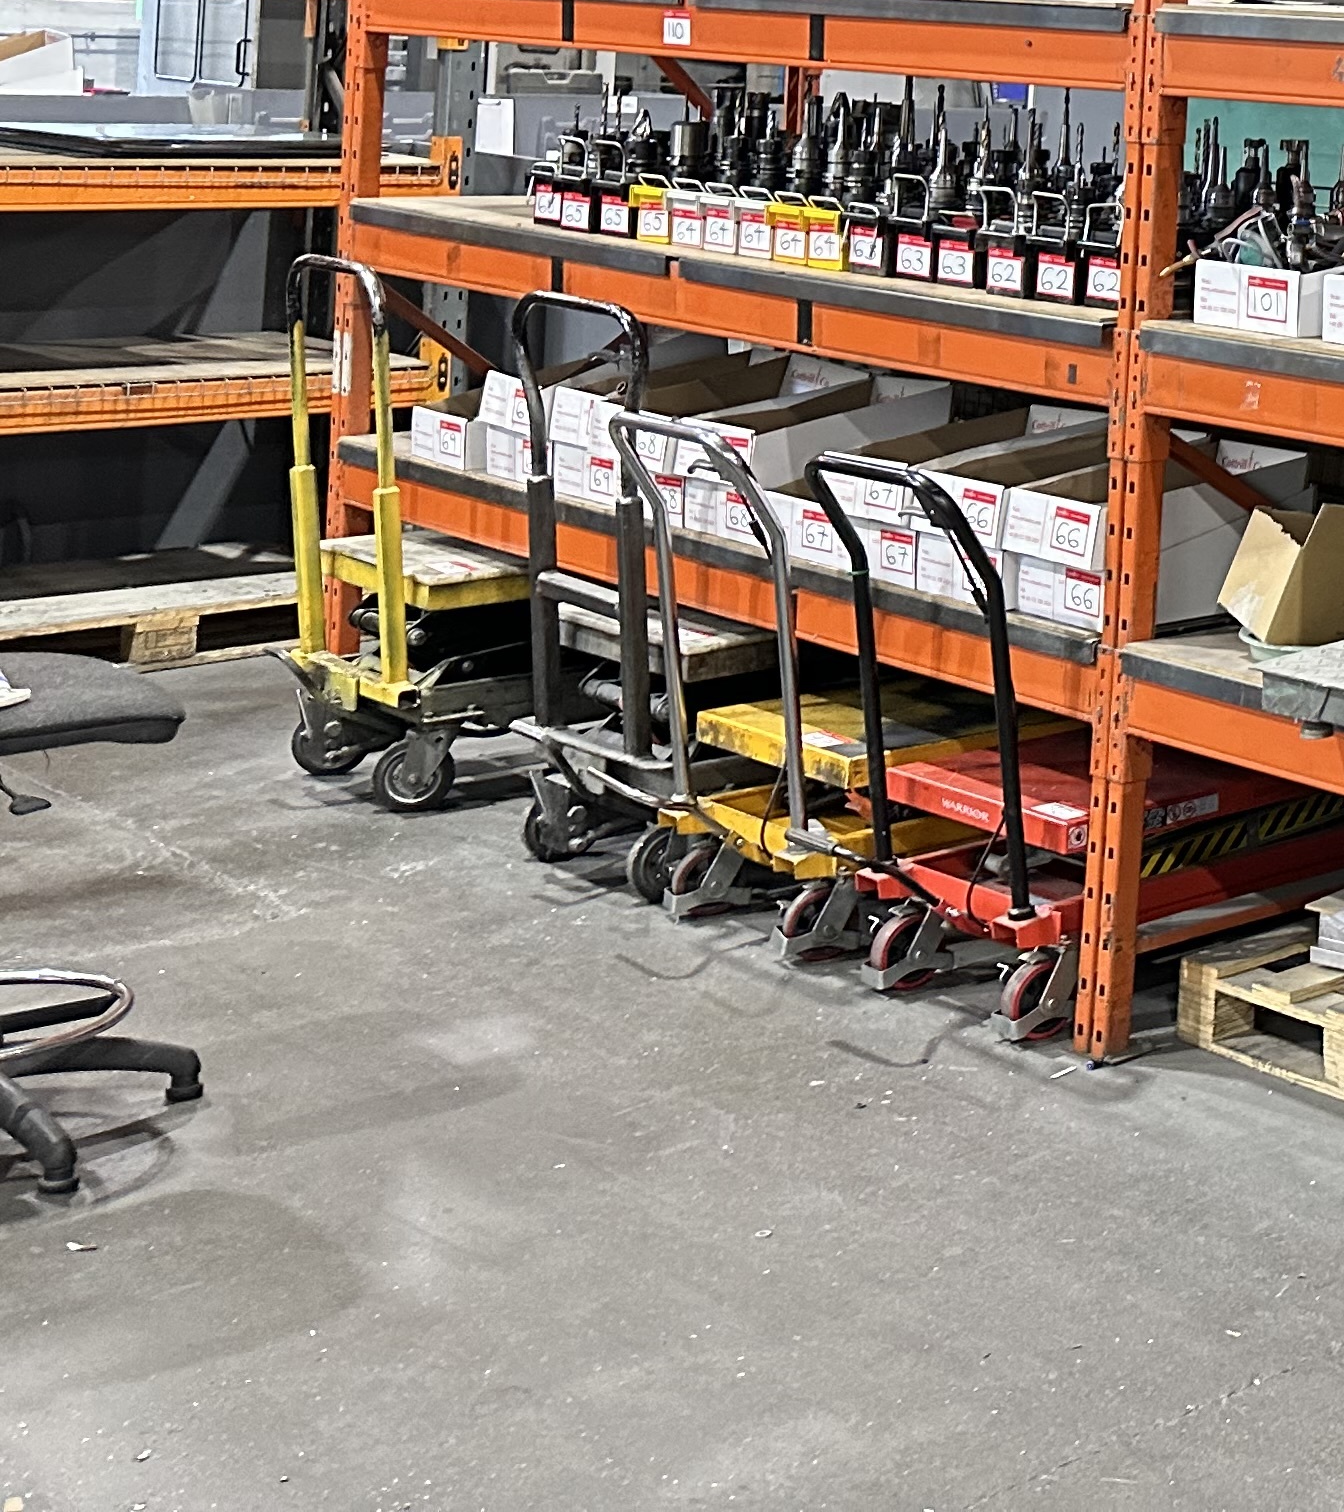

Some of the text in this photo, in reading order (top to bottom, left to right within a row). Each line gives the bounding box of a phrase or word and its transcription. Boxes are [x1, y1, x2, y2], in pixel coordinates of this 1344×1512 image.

[668, 21, 684, 39] 110
[564, 204, 585, 223] 65
[604, 208, 624, 226] 65
[644, 211, 666, 232] 65
[676, 221, 697, 242] 64
[709, 221, 729, 243] 64
[743, 223, 765, 247] 64
[780, 232, 802, 253] 64
[814, 235, 835, 256] 64
[901, 247, 924, 271] 63
[942, 253, 966, 275] 63
[991, 261, 1017, 283] 62
[1041, 266, 1068, 291] 62
[1093, 270, 1120, 292] 62
[1253, 289, 1279, 316] 101
[442, 432, 456, 453] 69
[593, 468, 611, 492] 69
[805, 523, 829, 547] 67
[1056, 522, 1081, 548] 66
[885, 544, 909, 567] 67
[1071, 584, 1094, 609] 66
[941, 797, 990, 823] WARRIOR
